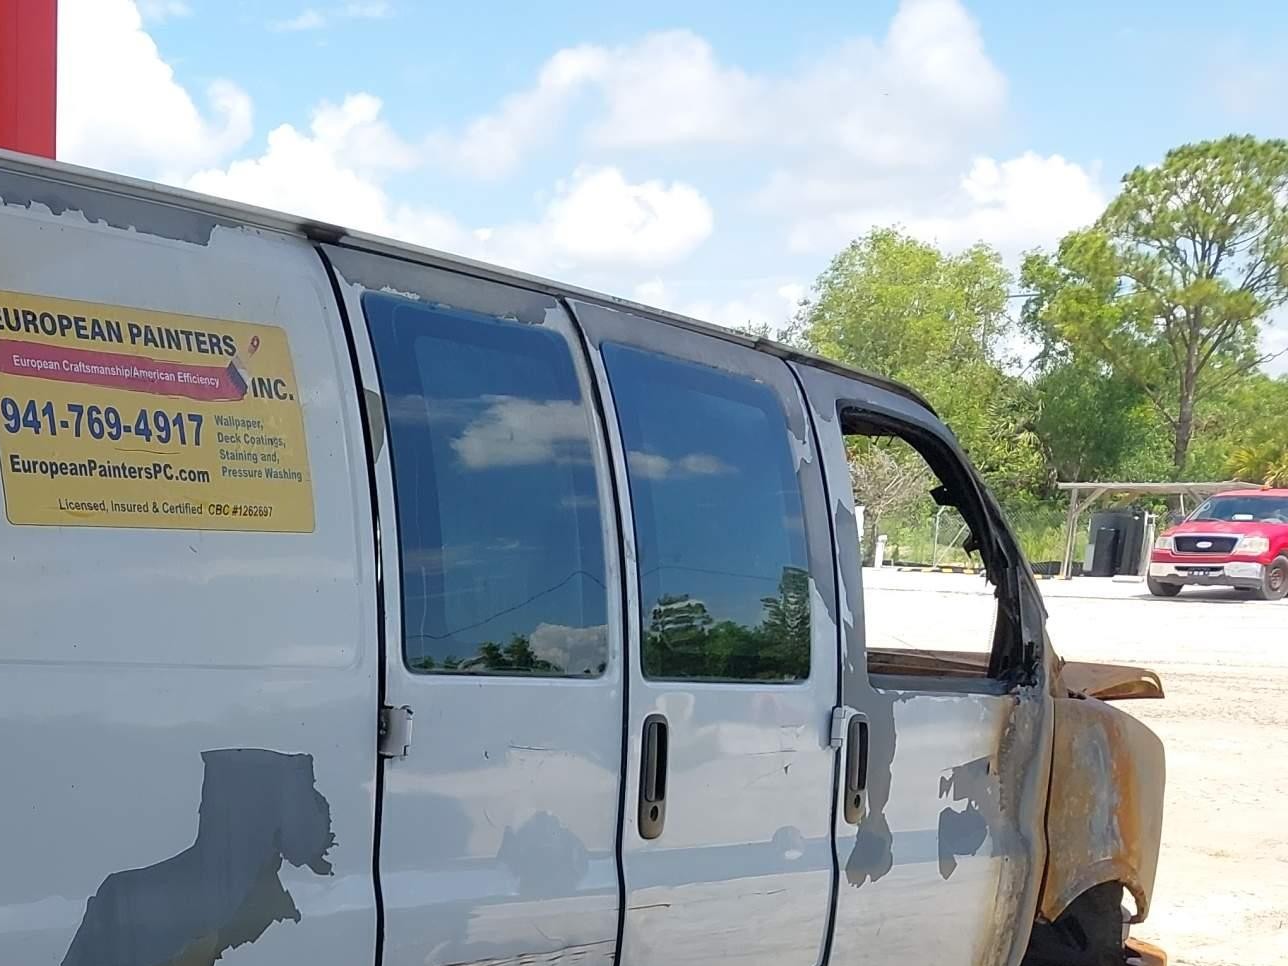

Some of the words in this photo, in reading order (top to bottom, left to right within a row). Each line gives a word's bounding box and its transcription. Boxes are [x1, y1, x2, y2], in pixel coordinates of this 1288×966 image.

[128, 323, 237, 357] PAINTERS
[12, 355, 61, 371] European
[177, 371, 220, 389] Efficiency
[251, 376, 295, 401] INC.
[0, 397, 203, 447] 941-769-4917
[214, 415, 264, 431] Wallpaper,
[217, 432, 241, 443] Deck
[244, 433, 286, 449] Coatings,
[219, 449, 258, 464] Staining
[261, 452, 280, 465] and,
[9, 454, 211, 484] EuropeanPaintersPC.com
[222, 465, 263, 479] Pressure
[264, 467, 303, 483] Washing
[58, 498, 109, 513] Licensed,
[111, 500, 149, 513] Insured
[152, 501, 160, 513] &
[162, 501, 204, 515] Certified
[208, 503, 230, 516] CBC
